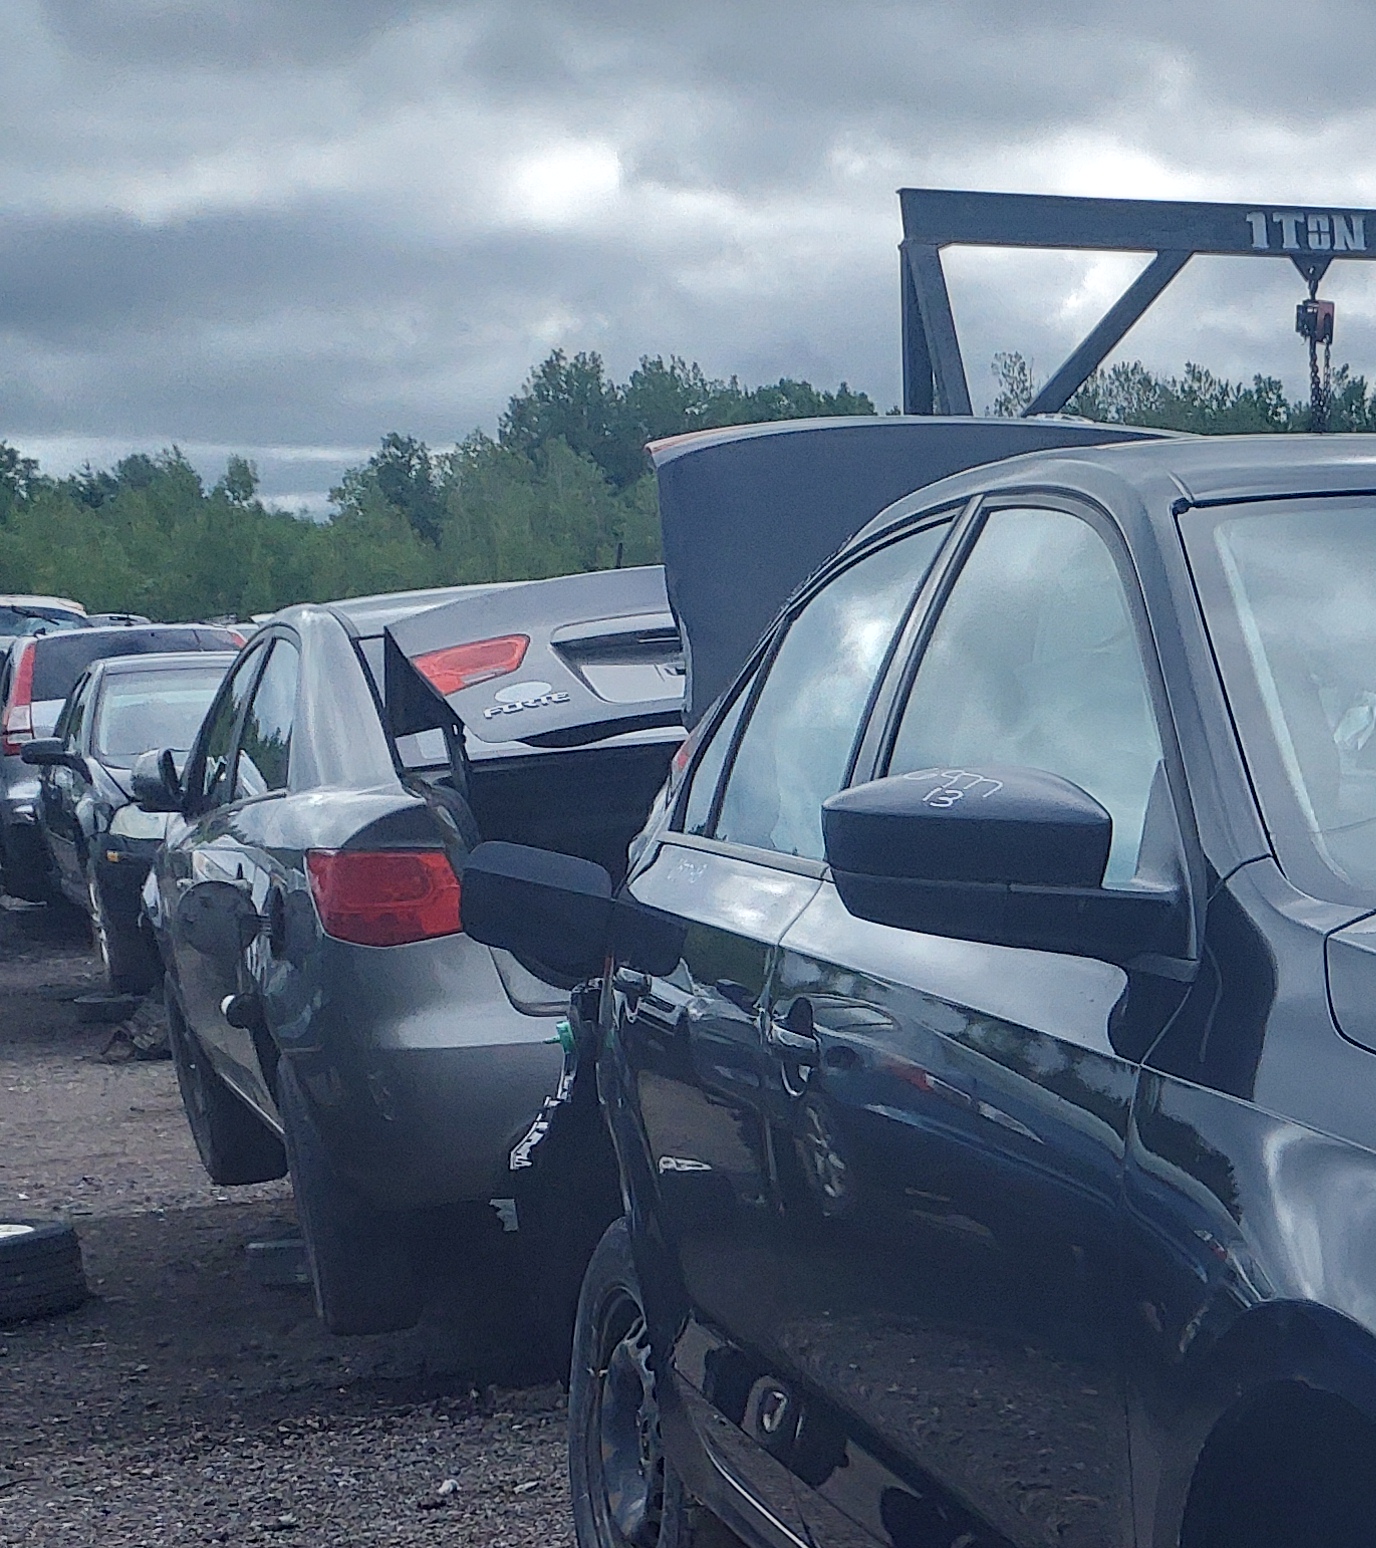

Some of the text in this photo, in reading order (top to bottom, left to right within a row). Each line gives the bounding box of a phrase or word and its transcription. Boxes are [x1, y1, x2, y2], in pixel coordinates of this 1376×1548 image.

[1246, 211, 1367, 251] 1 TON
[483, 691, 571, 720] FORTE
[903, 767, 1004, 798] 6977
[922, 787, 965, 808] 13
